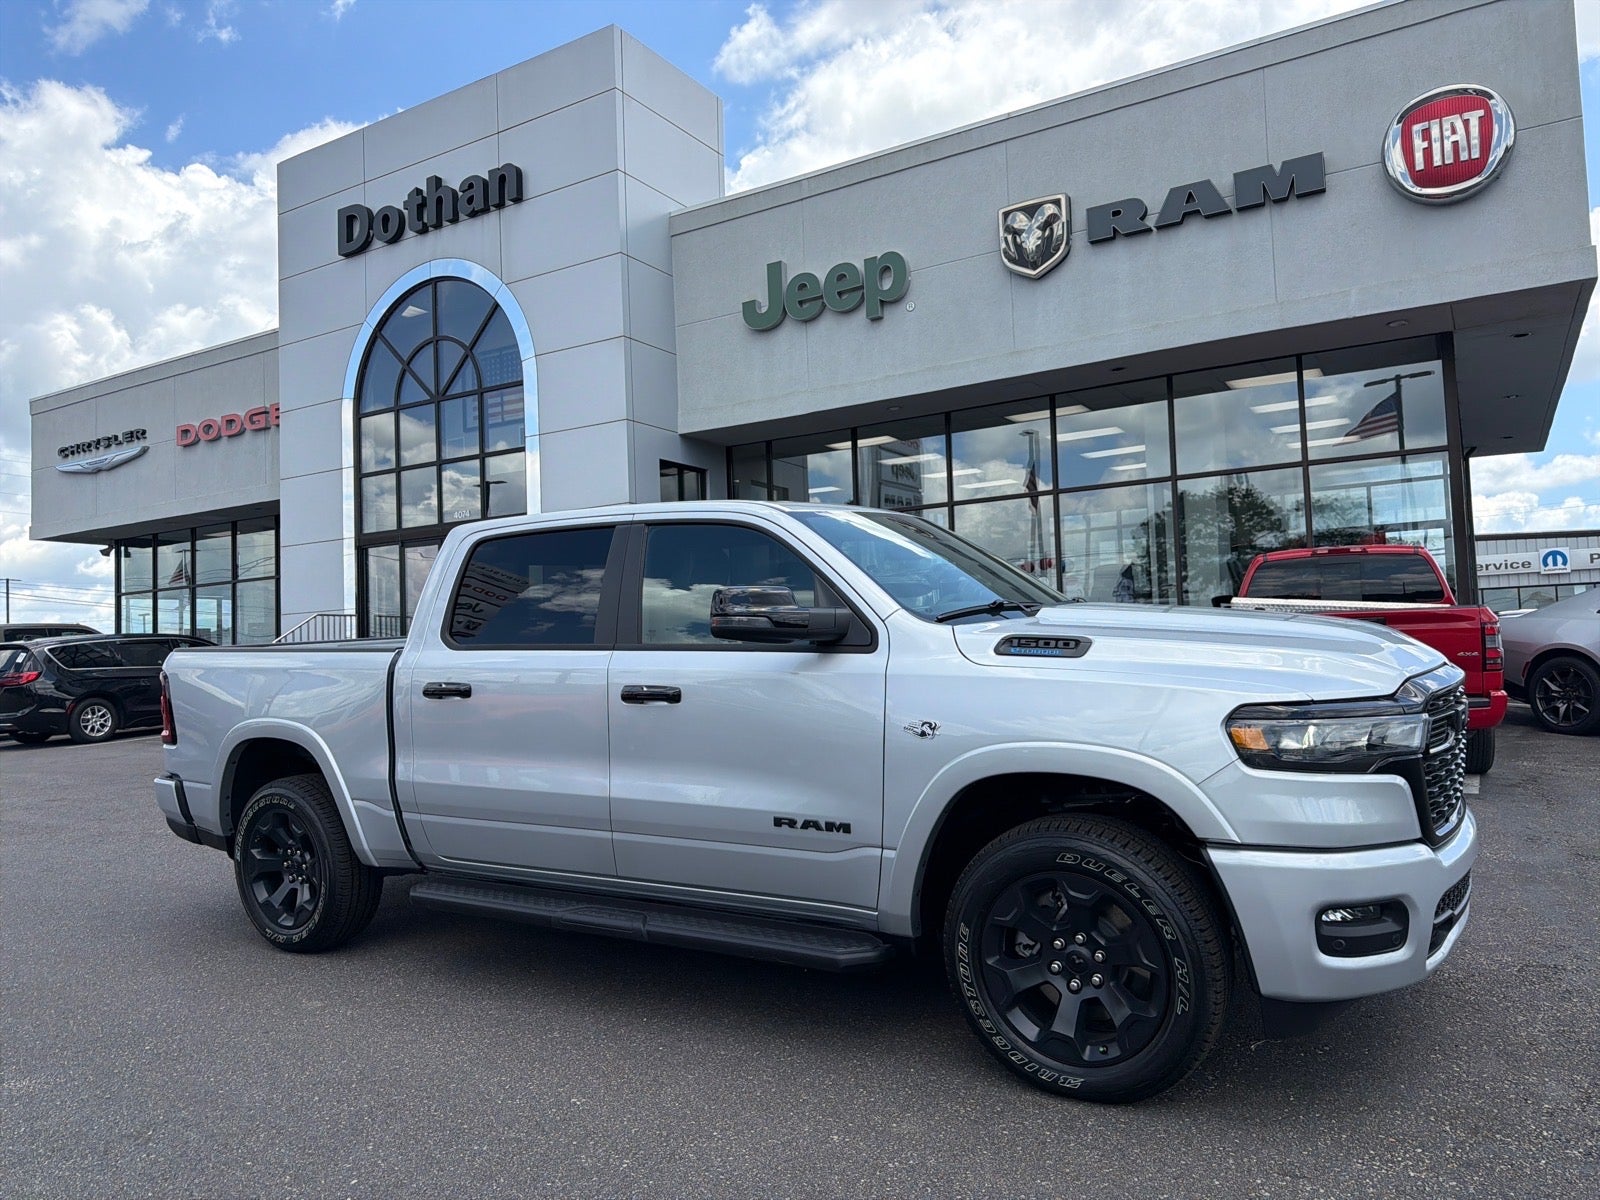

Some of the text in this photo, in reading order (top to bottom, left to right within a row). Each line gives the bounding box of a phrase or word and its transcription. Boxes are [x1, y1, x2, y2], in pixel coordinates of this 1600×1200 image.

[1412, 109, 1485, 172] FIAT
[337, 163, 524, 258] Dothan
[1086, 151, 1326, 244] RAM
[742, 251, 911, 331] Jeep
[58, 428, 148, 458] CHRYSLER
[176, 402, 280, 447] DODGE
[453, 510, 470, 519] 4074
[1476, 559, 1532, 572] ervice
[1007, 638, 1076, 649] 1500
[773, 815, 851, 834] RAM
[1056, 852, 1177, 941] DUELER
[958, 922, 1085, 1089] BRIDGESTONE
